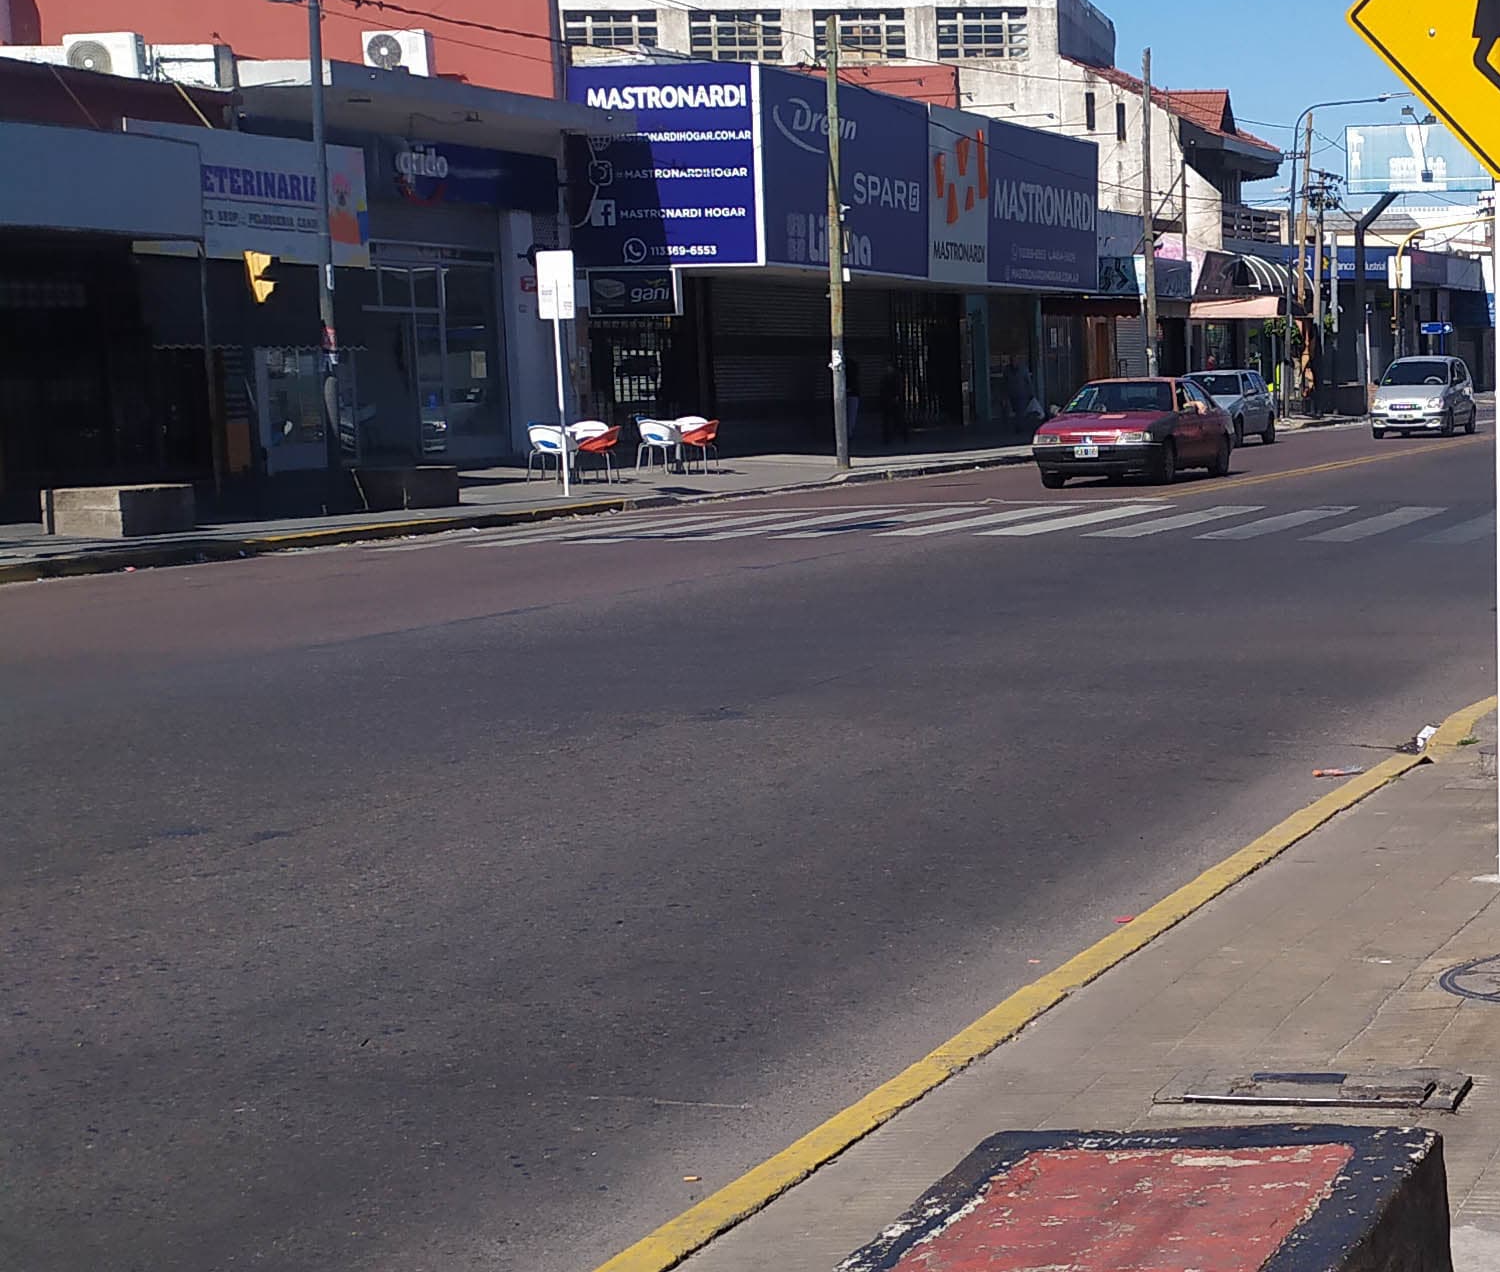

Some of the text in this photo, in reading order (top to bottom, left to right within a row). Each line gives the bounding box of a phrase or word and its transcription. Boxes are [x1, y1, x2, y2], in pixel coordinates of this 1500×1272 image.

[587, 85, 746, 110] MASTRONARDI
[620, 207, 746, 218] MASTRONARDI HOGAR
[994, 179, 1094, 231] MASTRONARDI
[933, 240, 985, 263] MASTRONARDI
